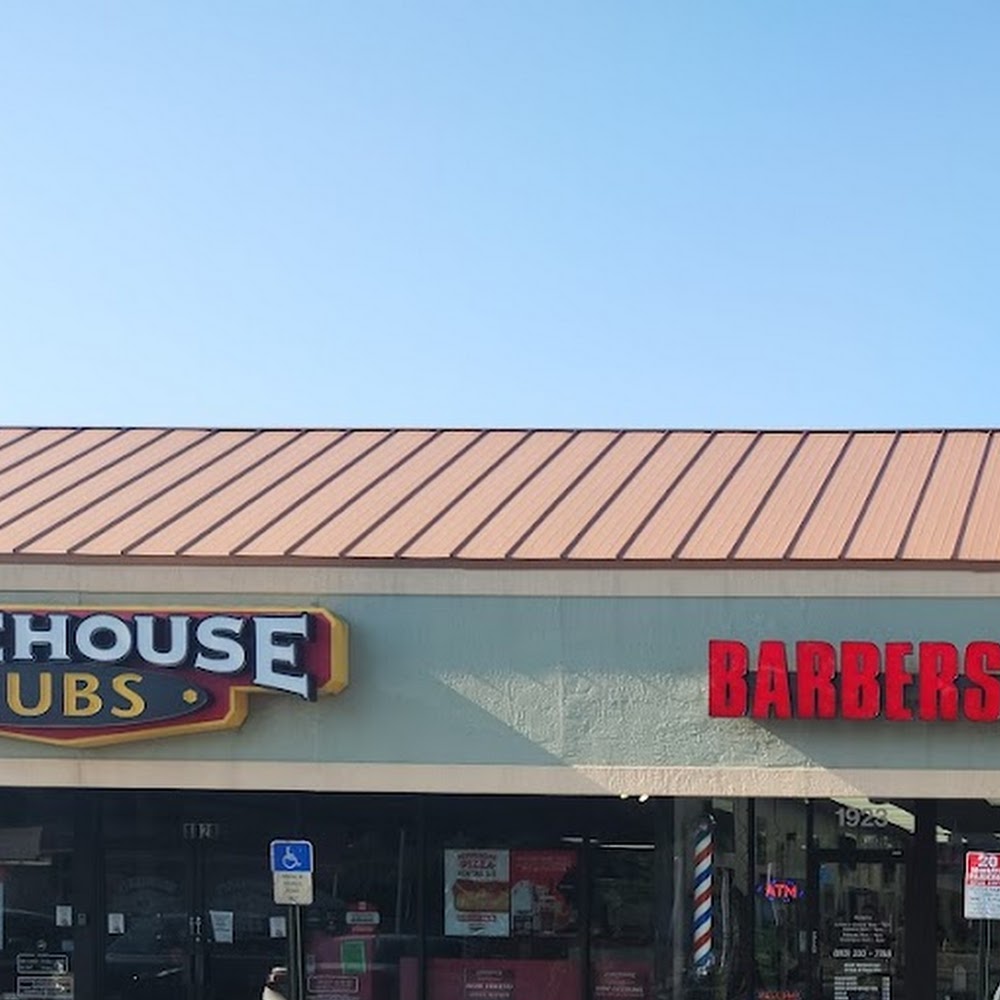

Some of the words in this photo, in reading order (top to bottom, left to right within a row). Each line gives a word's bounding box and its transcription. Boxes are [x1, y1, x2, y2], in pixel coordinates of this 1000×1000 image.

[0, 613, 312, 701] HOUSE
[835, 807, 889, 828] 1923
[765, 883, 798, 899] ATM
